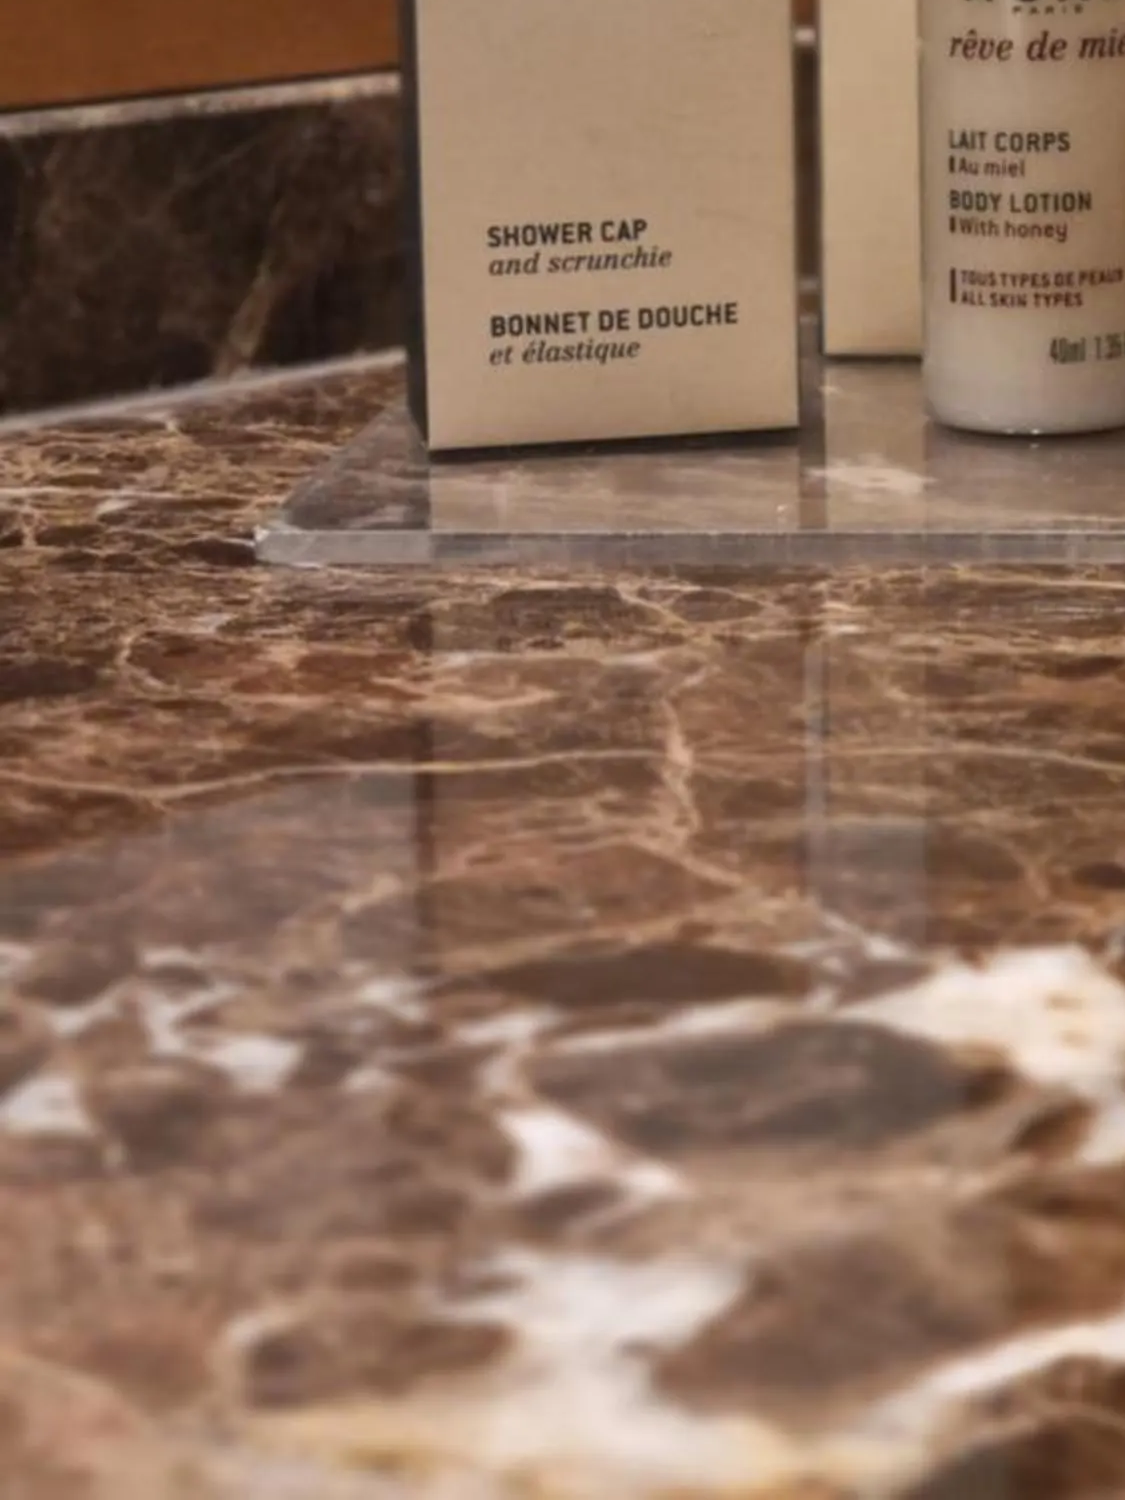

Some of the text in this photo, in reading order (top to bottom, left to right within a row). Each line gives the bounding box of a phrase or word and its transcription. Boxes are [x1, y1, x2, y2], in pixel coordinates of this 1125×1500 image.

[949, 27, 1014, 62] rêve
[1026, 29, 1067, 62] de
[949, 129, 1071, 151] LAIT CORPS
[959, 157, 1026, 177] Au miel
[950, 189, 1093, 213] BODY LOTION
[487, 218, 648, 248] SHOWER CAP
[959, 216, 1068, 243] With honey
[488, 245, 672, 276] and scrunchie
[1000, 271, 1050, 288] TYPES
[960, 289, 1083, 308] ALL SKIN TYPES
[490, 302, 738, 337] BONNET DE DOUCHE
[489, 338, 641, 365] et élastique
